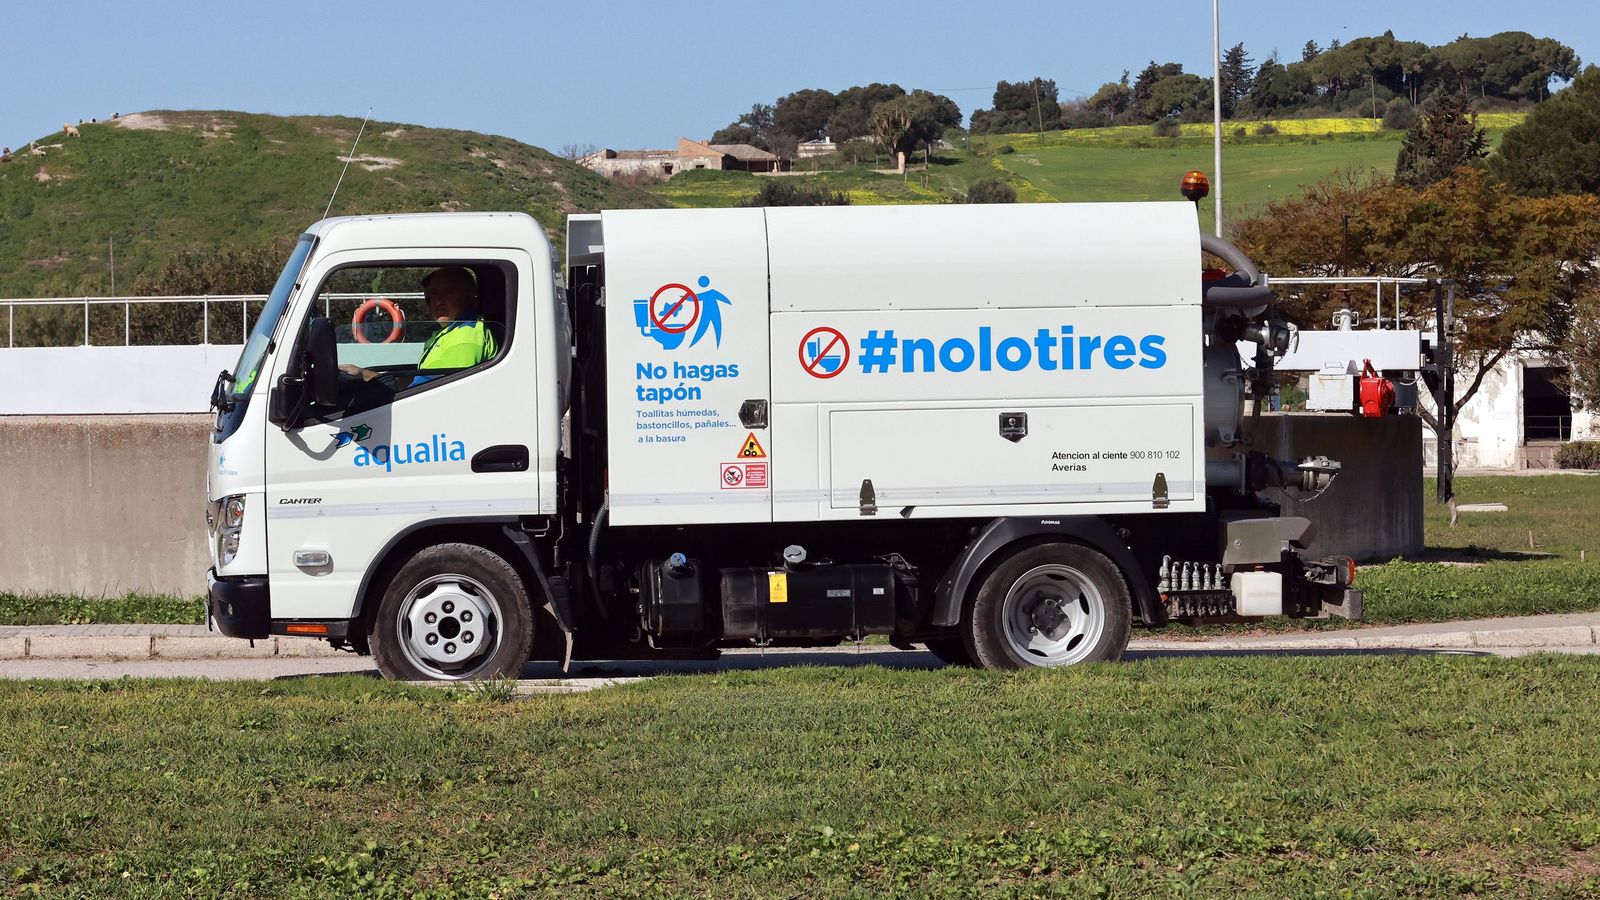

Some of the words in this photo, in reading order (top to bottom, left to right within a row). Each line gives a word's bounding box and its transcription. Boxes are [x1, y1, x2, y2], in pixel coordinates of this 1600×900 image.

[858, 325, 1167, 374] #nolotires
[636, 362, 668, 379] No
[673, 361, 739, 382] hagas
[636, 382, 702, 404] tapón
[636, 410, 674, 418] Toallitas
[676, 408, 720, 418] húmedas,
[636, 421, 693, 430] bastoncillos,
[694, 420, 737, 430] pañales...
[645, 435, 654, 443] la
[655, 434, 686, 443] basura
[353, 433, 466, 473] aqualia
[1051, 451, 1090, 460] Atencion
[1092, 451, 1100, 460] al
[1102, 451, 1128, 460] ciente
[1129, 450, 1146, 460] 900
[1147, 450, 1163, 460] 810
[1165, 450, 1181, 460] 102
[279, 497, 323, 505] CANTER
